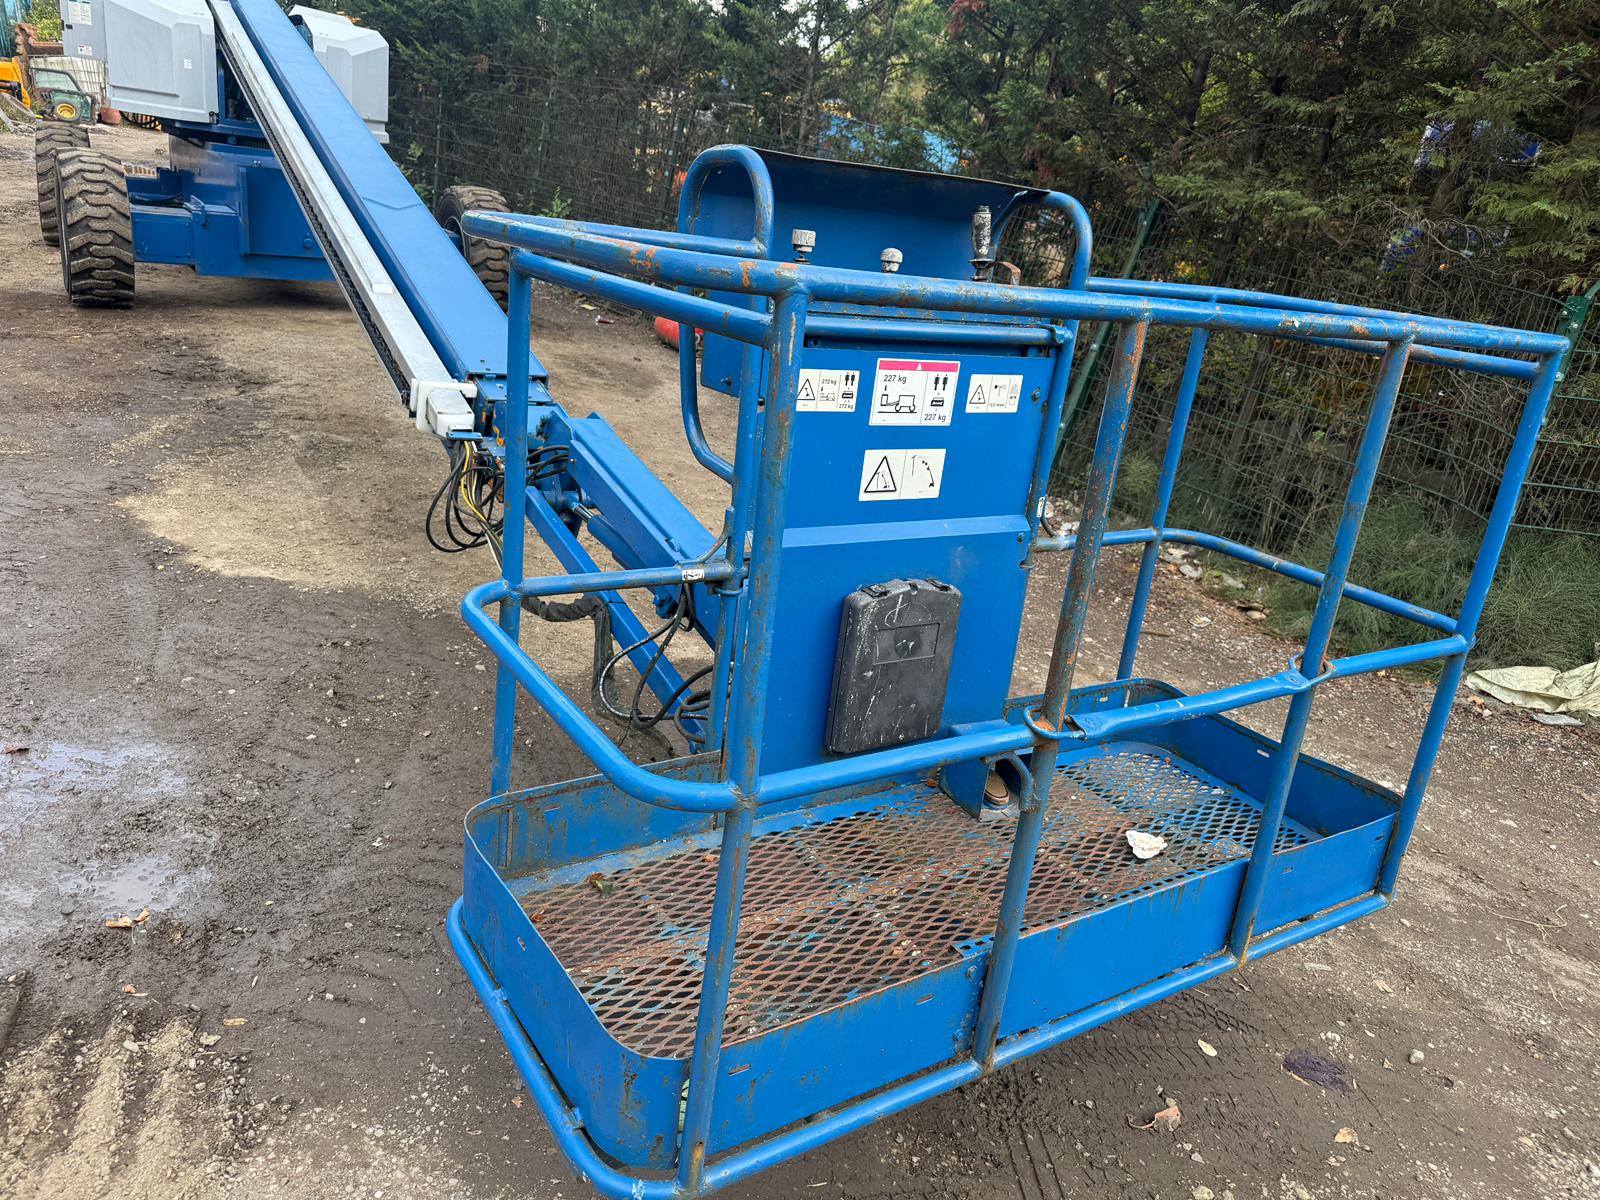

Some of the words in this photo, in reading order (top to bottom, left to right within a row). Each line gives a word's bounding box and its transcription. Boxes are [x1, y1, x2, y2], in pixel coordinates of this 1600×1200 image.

[883, 374, 897, 382] 227
[898, 375, 907, 384] kg
[924, 413, 937, 421] 227
[938, 413, 946, 423] kg
